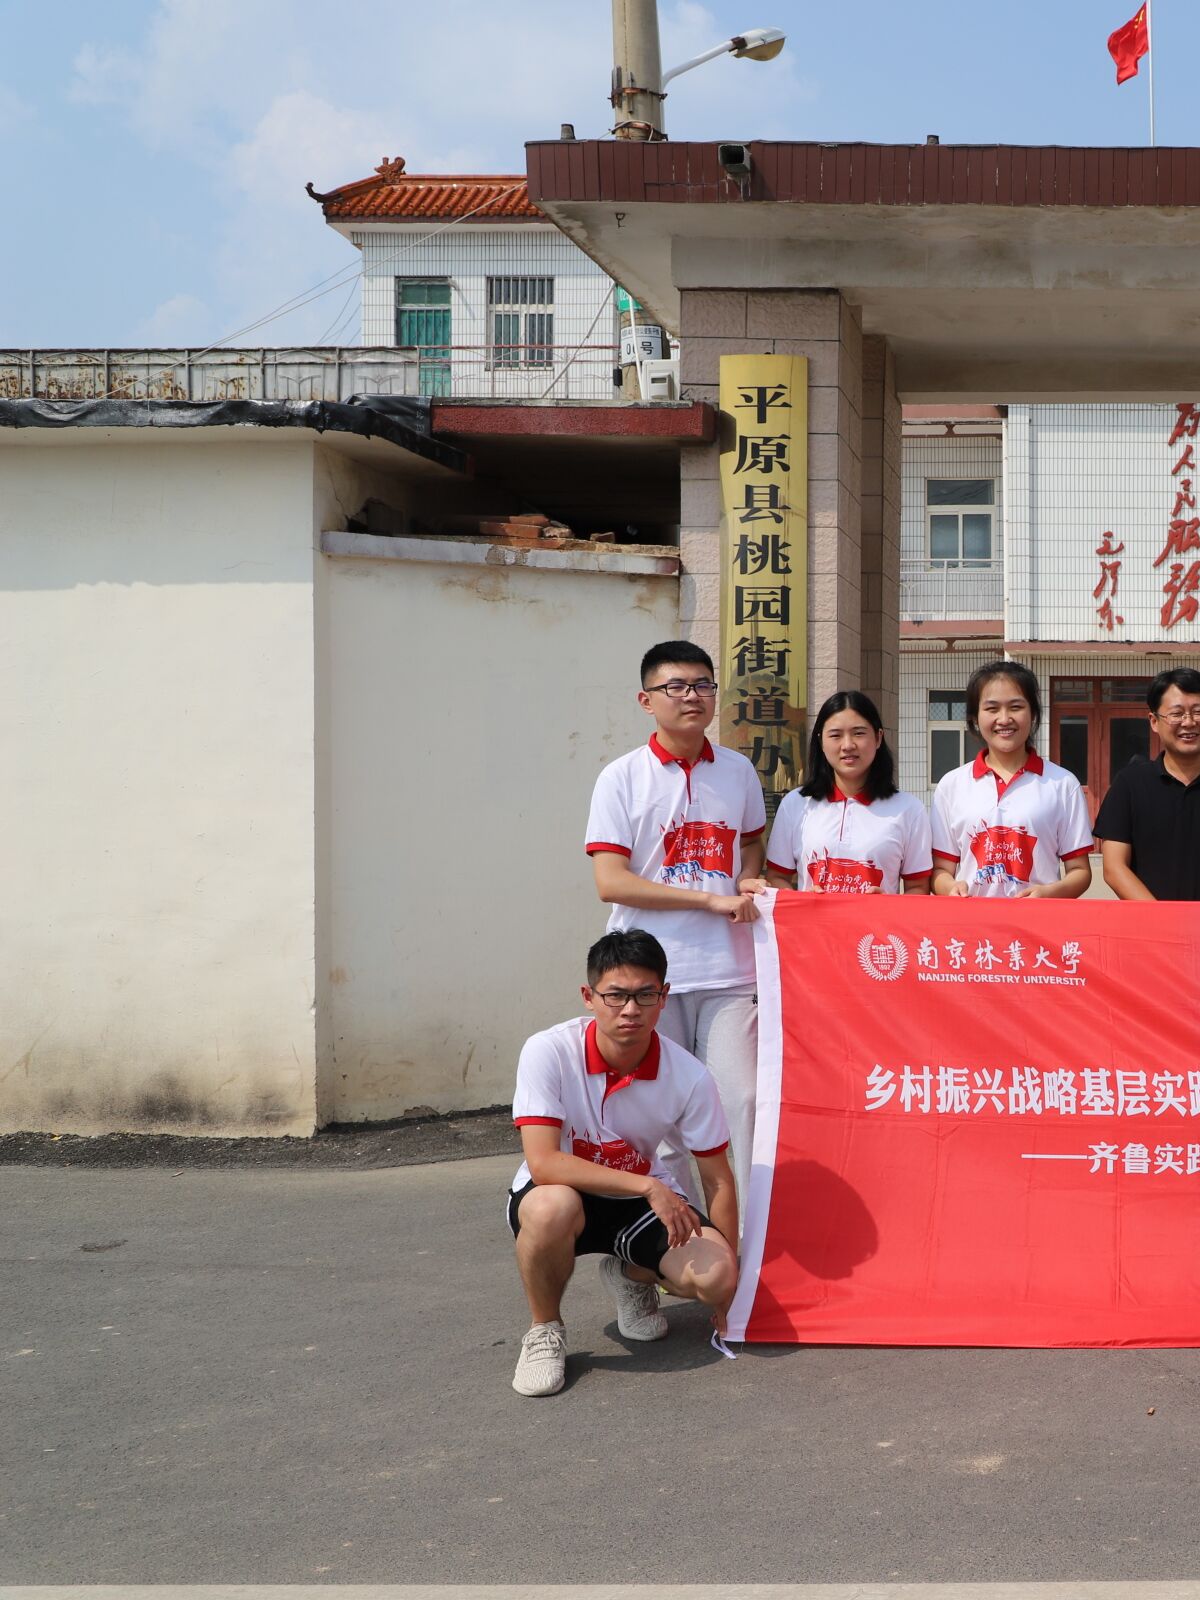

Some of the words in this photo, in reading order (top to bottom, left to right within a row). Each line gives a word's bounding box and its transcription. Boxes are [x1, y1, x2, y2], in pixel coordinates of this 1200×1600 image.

[918, 972, 965, 983] NANJING
[967, 973, 1020, 984] FORESTRY
[1023, 976, 1087, 986] UNIVERSITY
